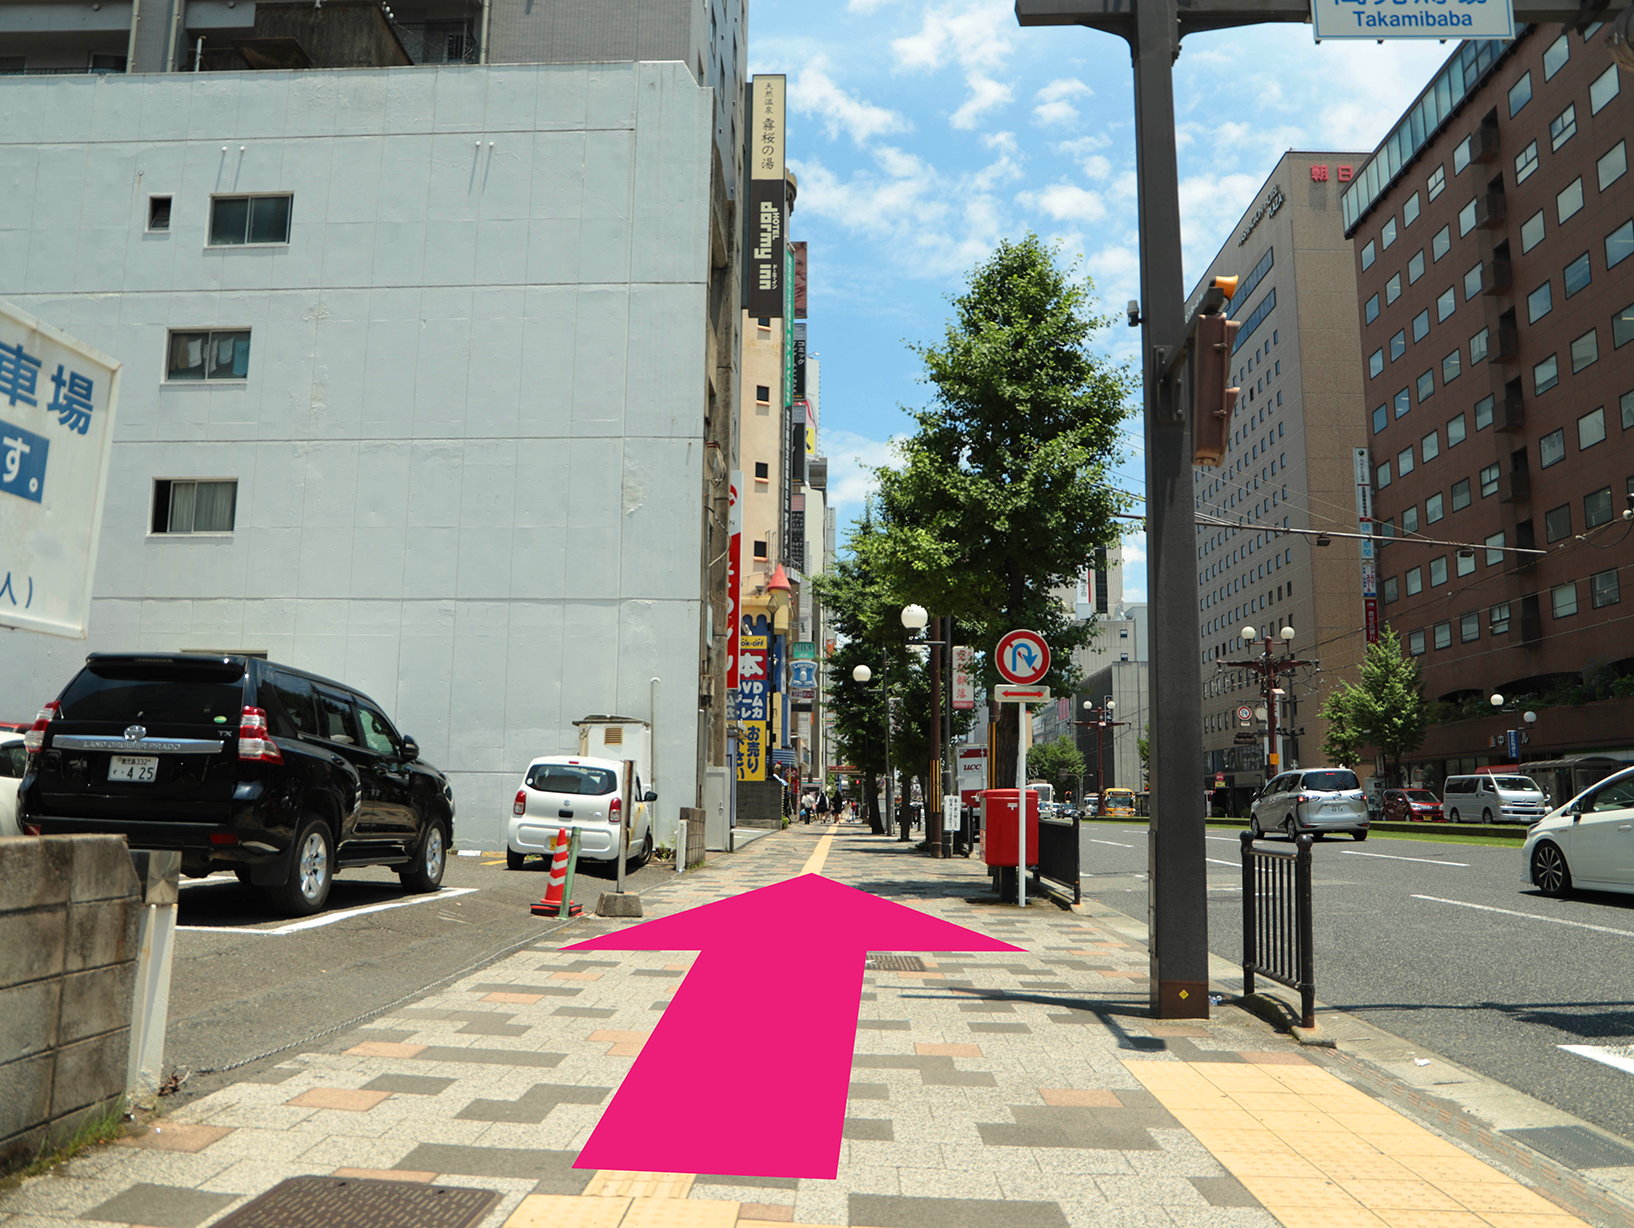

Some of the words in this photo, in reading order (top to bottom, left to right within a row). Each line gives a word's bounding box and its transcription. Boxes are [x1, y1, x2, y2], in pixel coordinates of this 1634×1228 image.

[1353, 11, 1472, 26] Takamibaba
[764, 82, 774, 114] 天然温泉
[761, 118, 776, 170] 霧桜の湯
[1310, 164, 1353, 182] 朝日
[754, 202, 778, 260] dormy
[759, 264, 772, 290] inn
[1362, 524, 1372, 557] 読新聞
[740, 652, 764, 678] 本
[747, 725, 760, 774] お売り
[138, 767, 154, 780] 25
